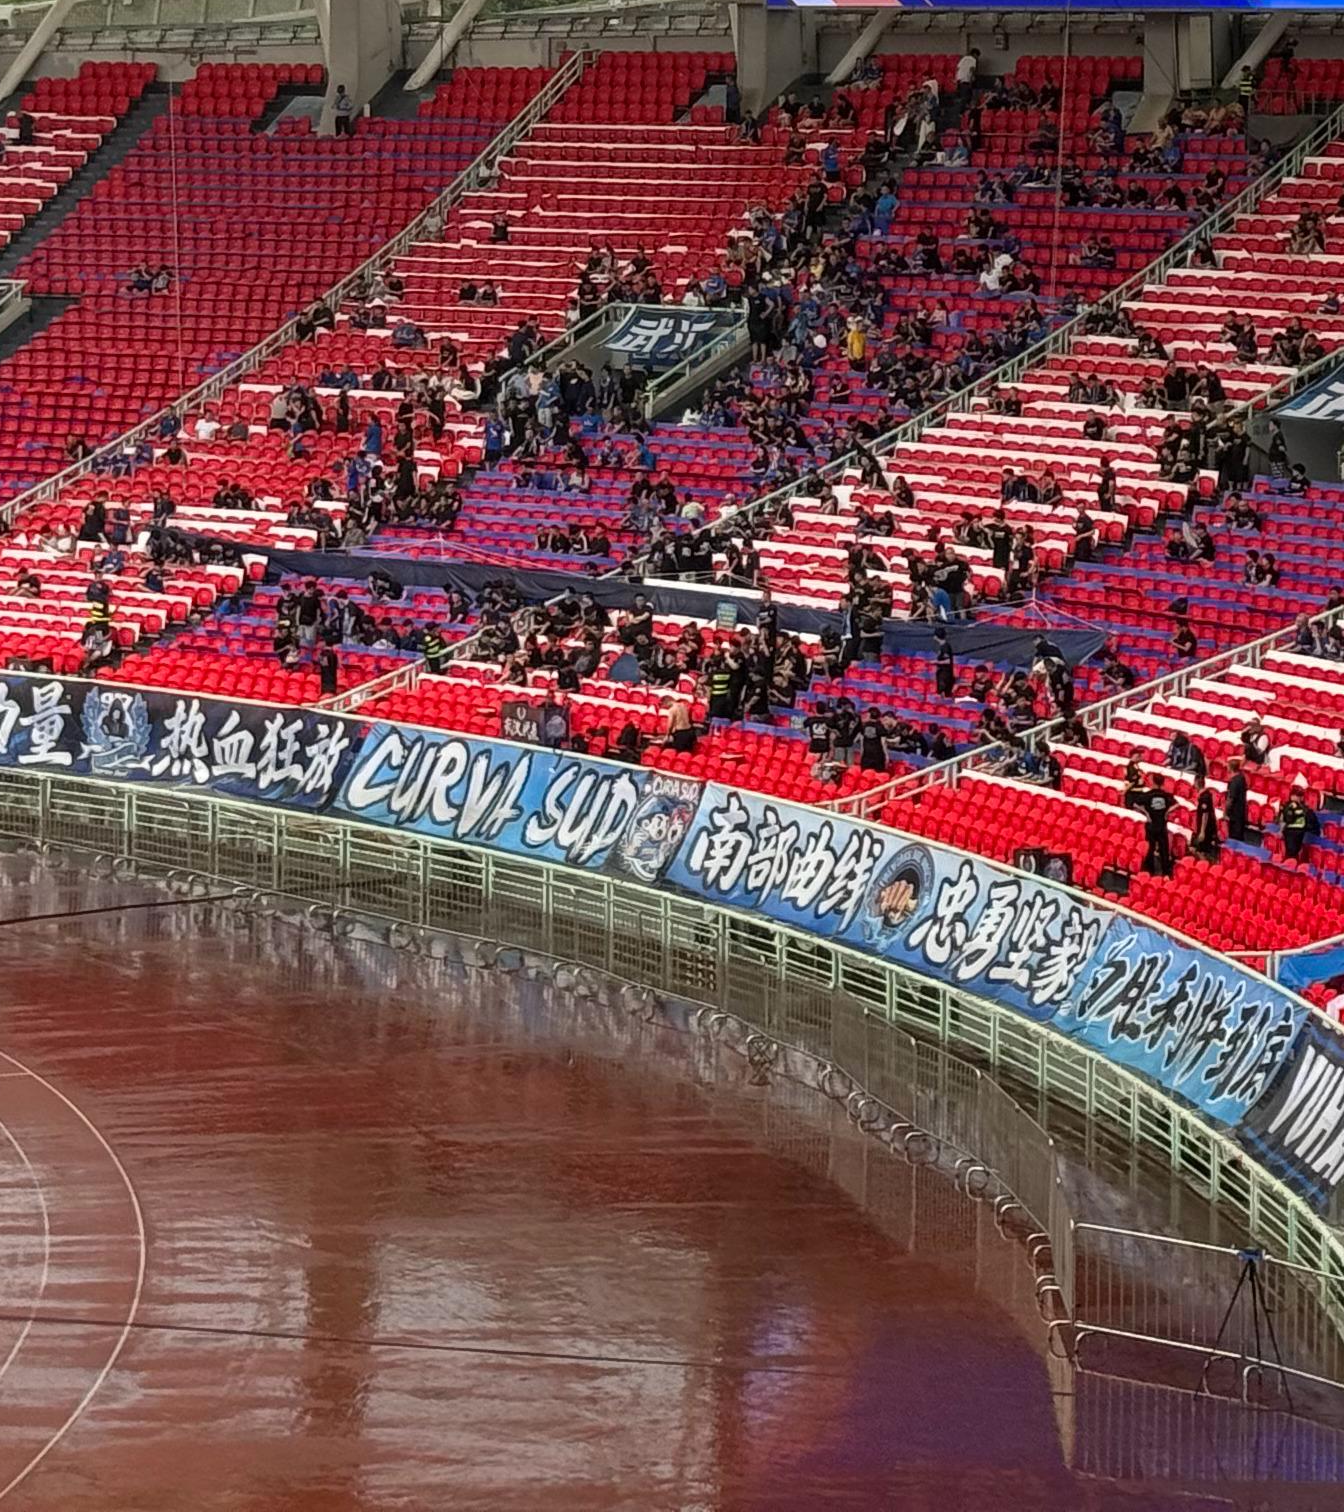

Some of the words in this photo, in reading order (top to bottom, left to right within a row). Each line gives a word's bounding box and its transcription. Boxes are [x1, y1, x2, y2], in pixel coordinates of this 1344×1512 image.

[151, 698, 351, 794] 热血狂放
[346, 730, 532, 839] CURVA
[524, 762, 638, 864] SUD
[687, 792, 884, 934] 南部曲线
[907, 860, 1100, 1006] 忠勇坚毅
